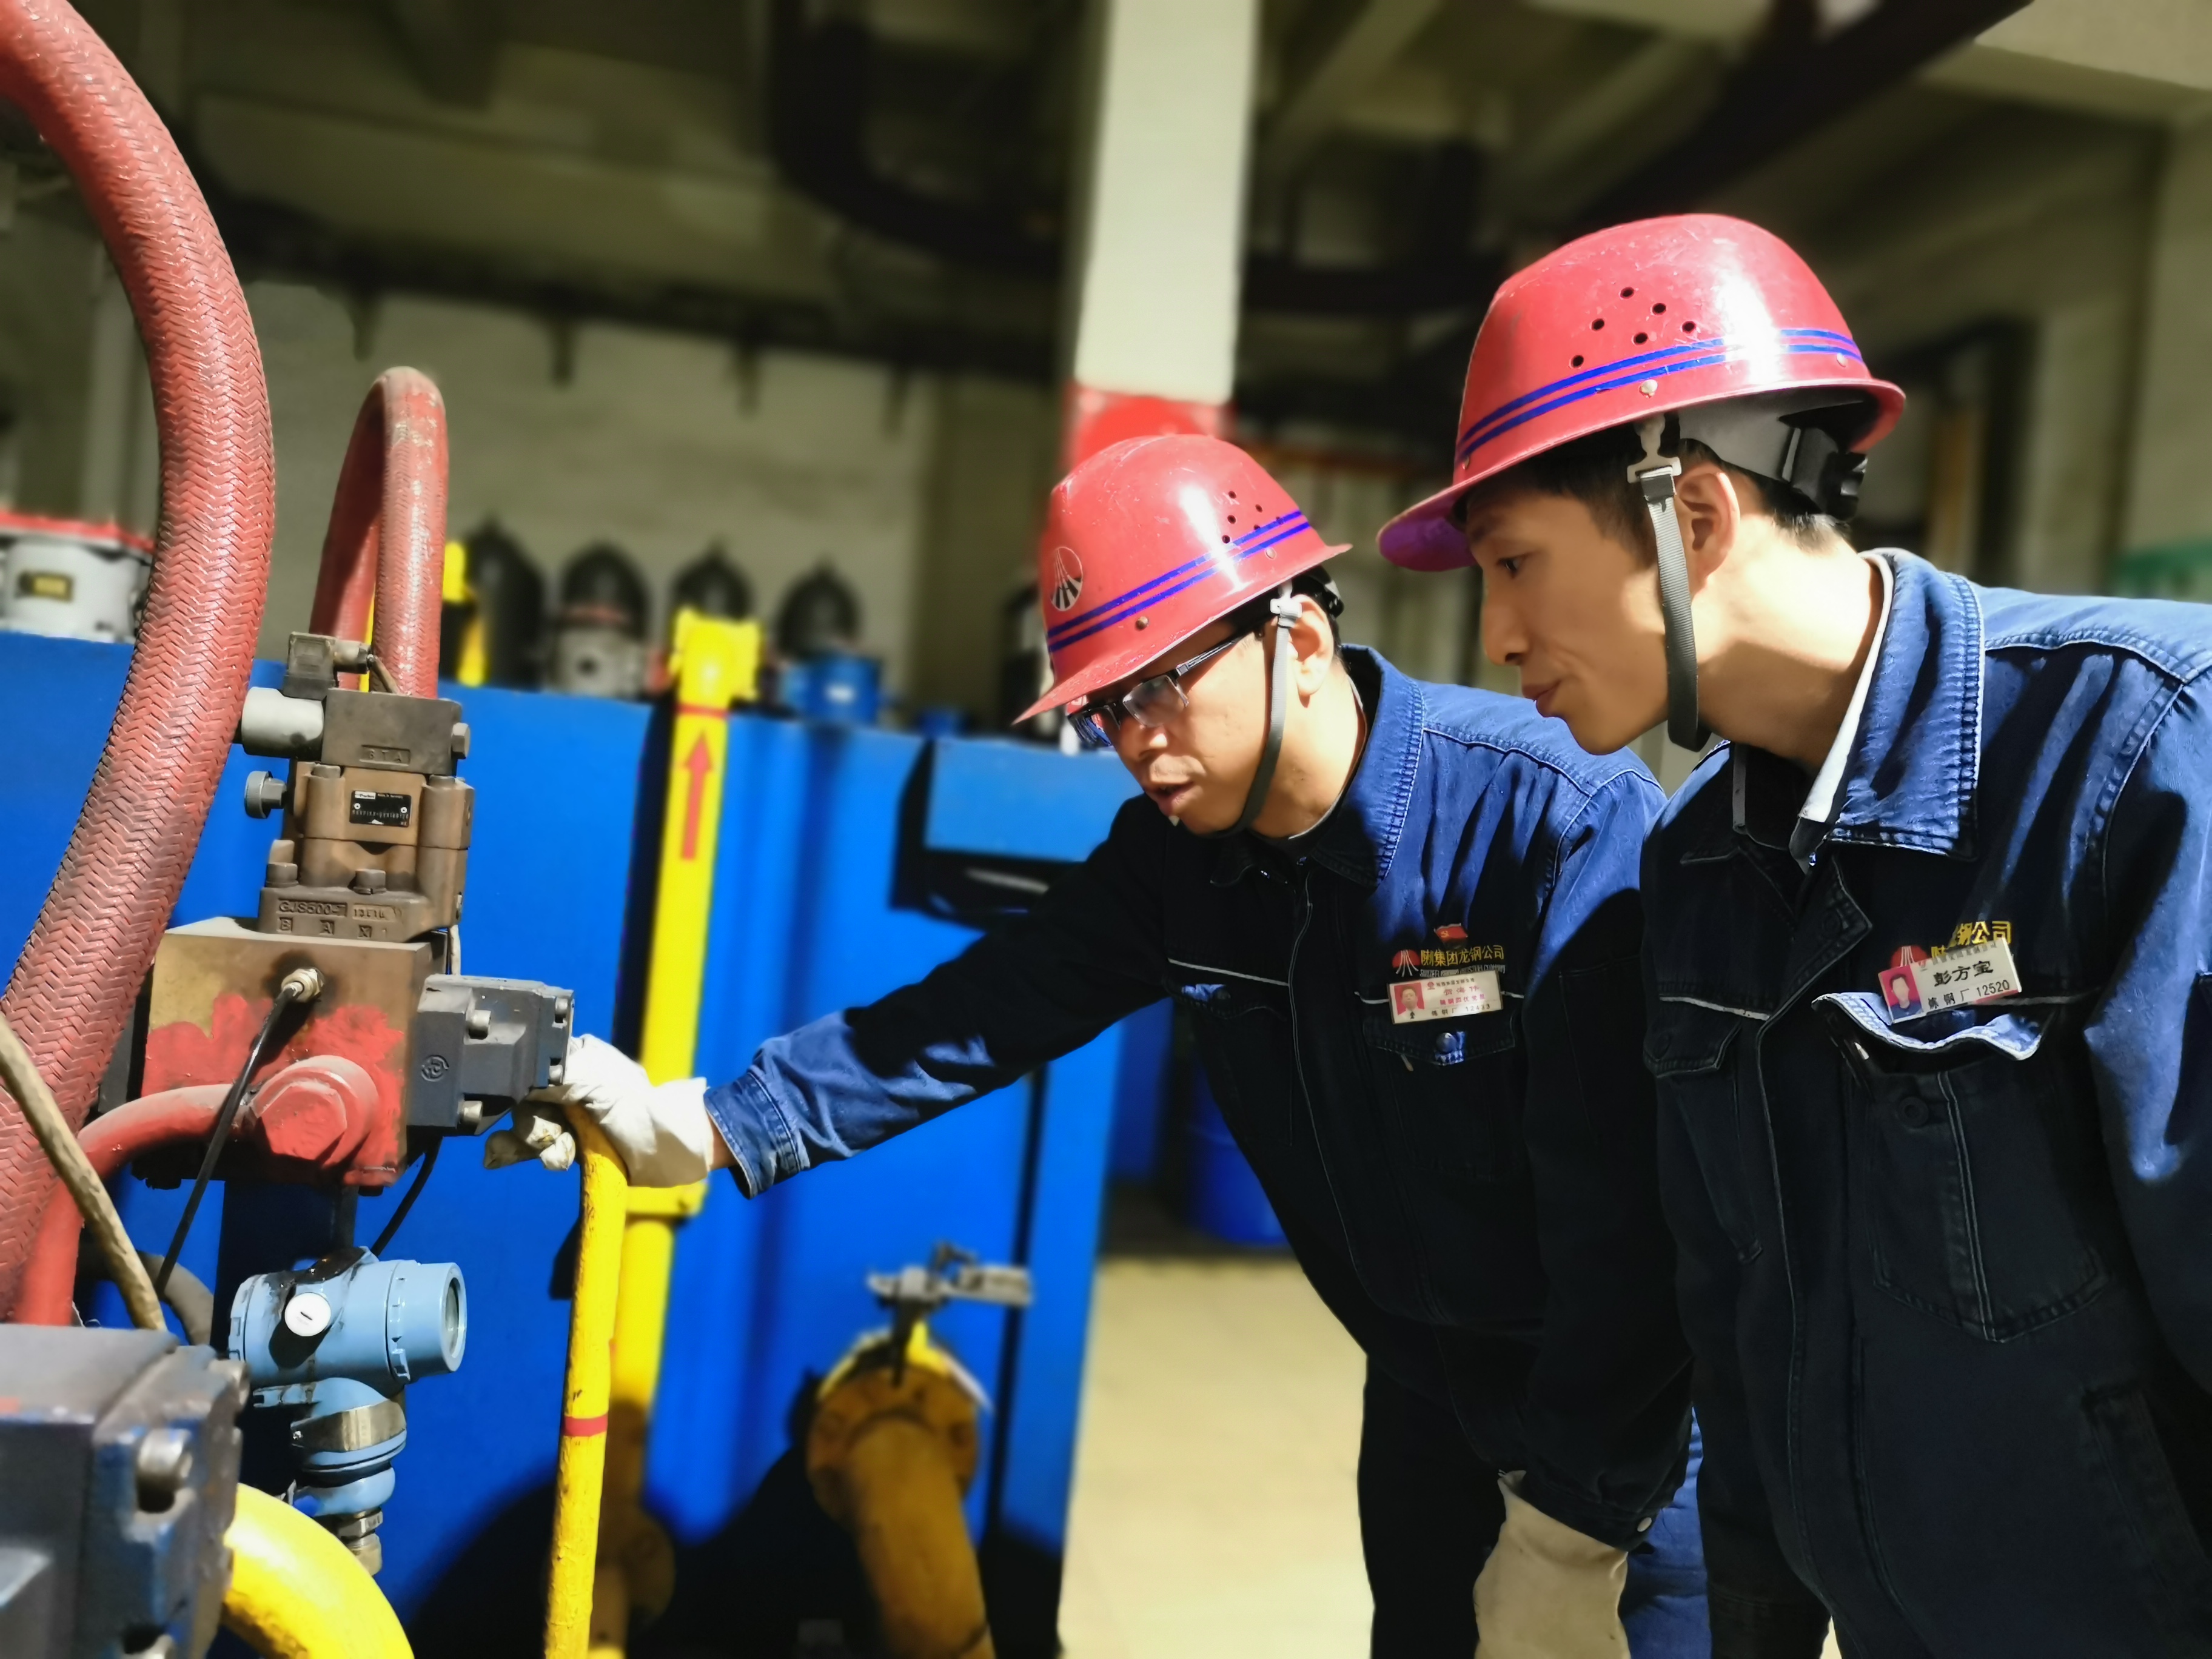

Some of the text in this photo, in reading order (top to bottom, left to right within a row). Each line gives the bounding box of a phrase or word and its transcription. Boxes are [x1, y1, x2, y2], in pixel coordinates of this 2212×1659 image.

[1934, 960, 1994, 987] 彭方宝
[1976, 979, 2010, 997] 12520
